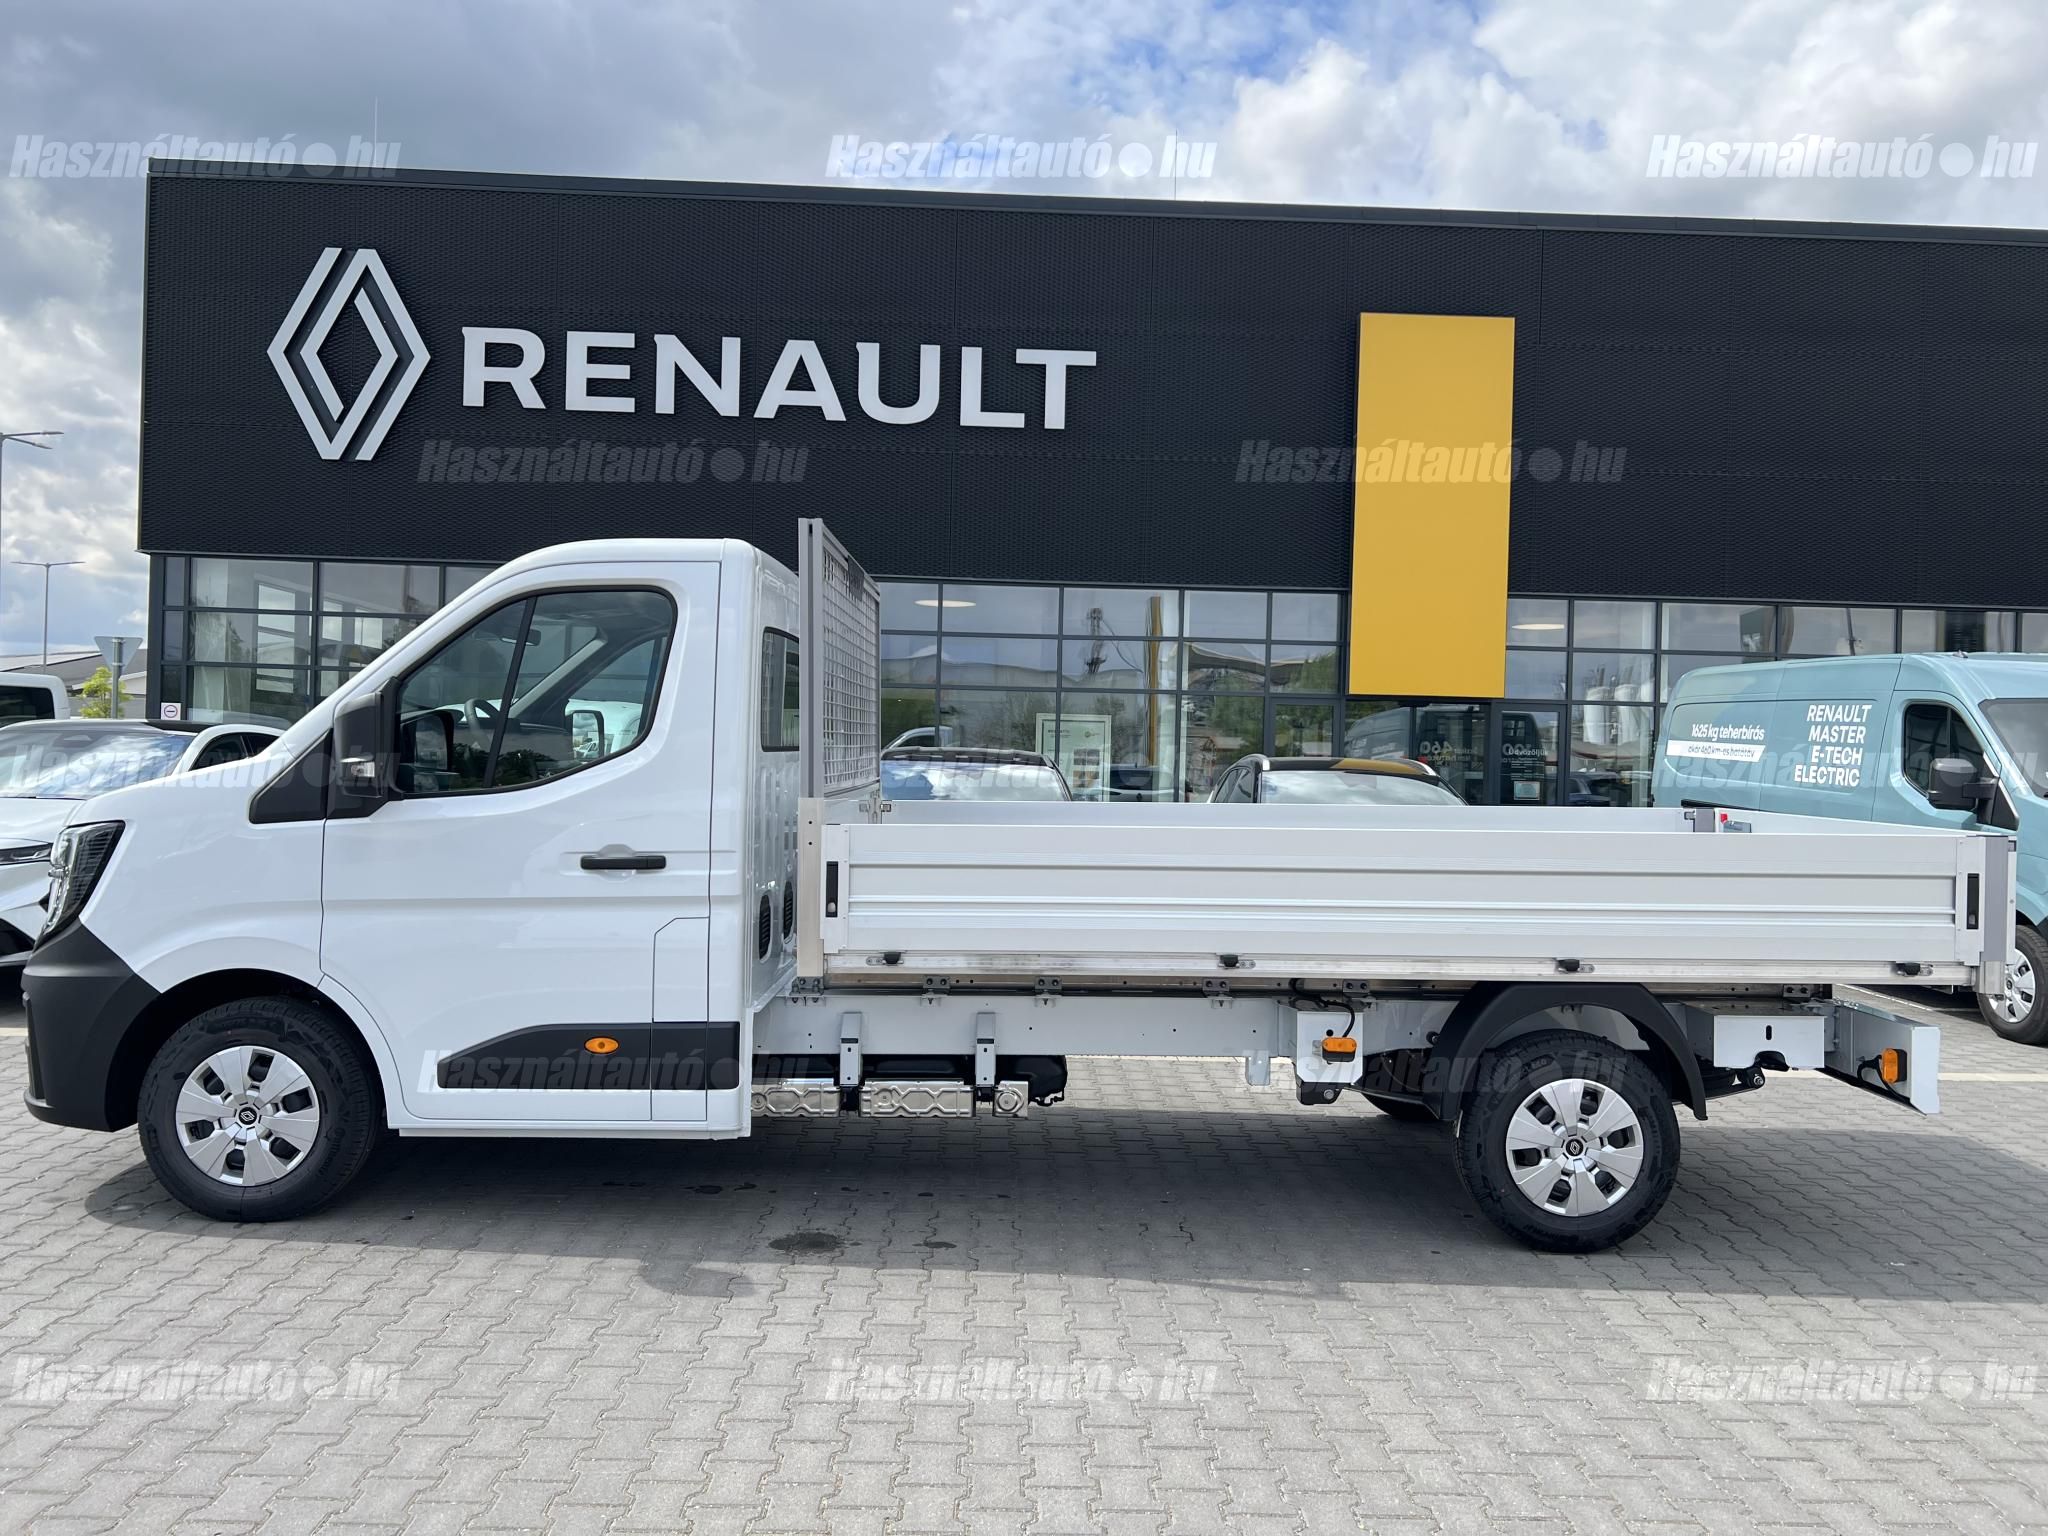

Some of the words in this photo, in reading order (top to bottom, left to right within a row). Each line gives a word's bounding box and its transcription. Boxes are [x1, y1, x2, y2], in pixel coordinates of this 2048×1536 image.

[461, 326, 1098, 430] RENAULT
[1807, 704, 1872, 722] RENAULT
[1692, 723, 1708, 738] 1625
[1708, 724, 1719, 741] kg
[1719, 724, 1765, 740] teherbírás
[1808, 725, 1867, 744] MASTER
[1811, 745, 1863, 765] E-TECH
[1794, 764, 1860, 787] ELECTRIC
